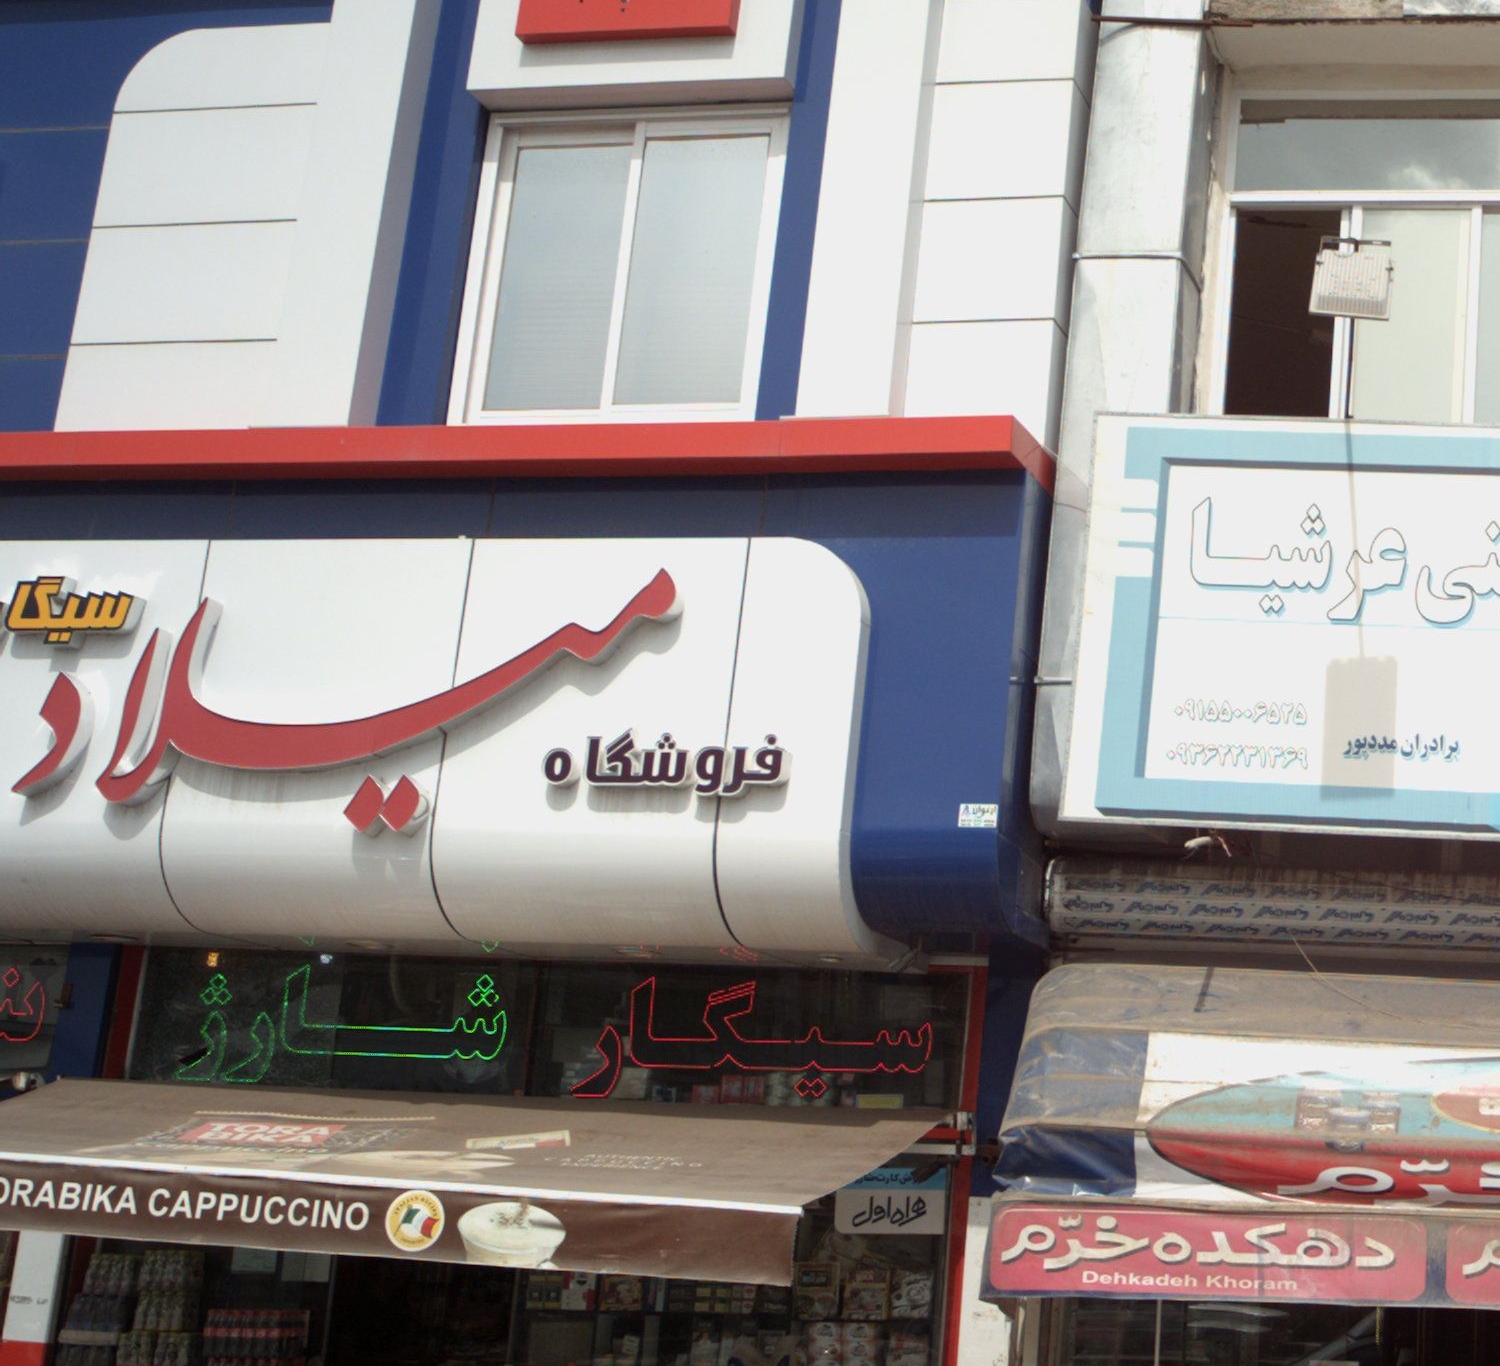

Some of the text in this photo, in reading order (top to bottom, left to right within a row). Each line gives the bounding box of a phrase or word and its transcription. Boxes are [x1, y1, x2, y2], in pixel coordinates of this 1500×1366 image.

[1189, 496, 1407, 622] عرشیا
[0, 576, 134, 644] سیگا
[10, 566, 788, 836] فروشگاه میلاد
[1401, 732, 1460, 760] برادران
[175, 962, 508, 1083] شارژ
[569, 975, 933, 1099] سیگار
[196, 1134, 315, 1144] BIKA
[205, 1121, 333, 1136] TORA
[148, 1187, 370, 1232] CAPPUCCINO
[1152, 1222, 1397, 1268] دهکده
[1082, 1270, 1298, 1292] Dehkadeh Khoram
